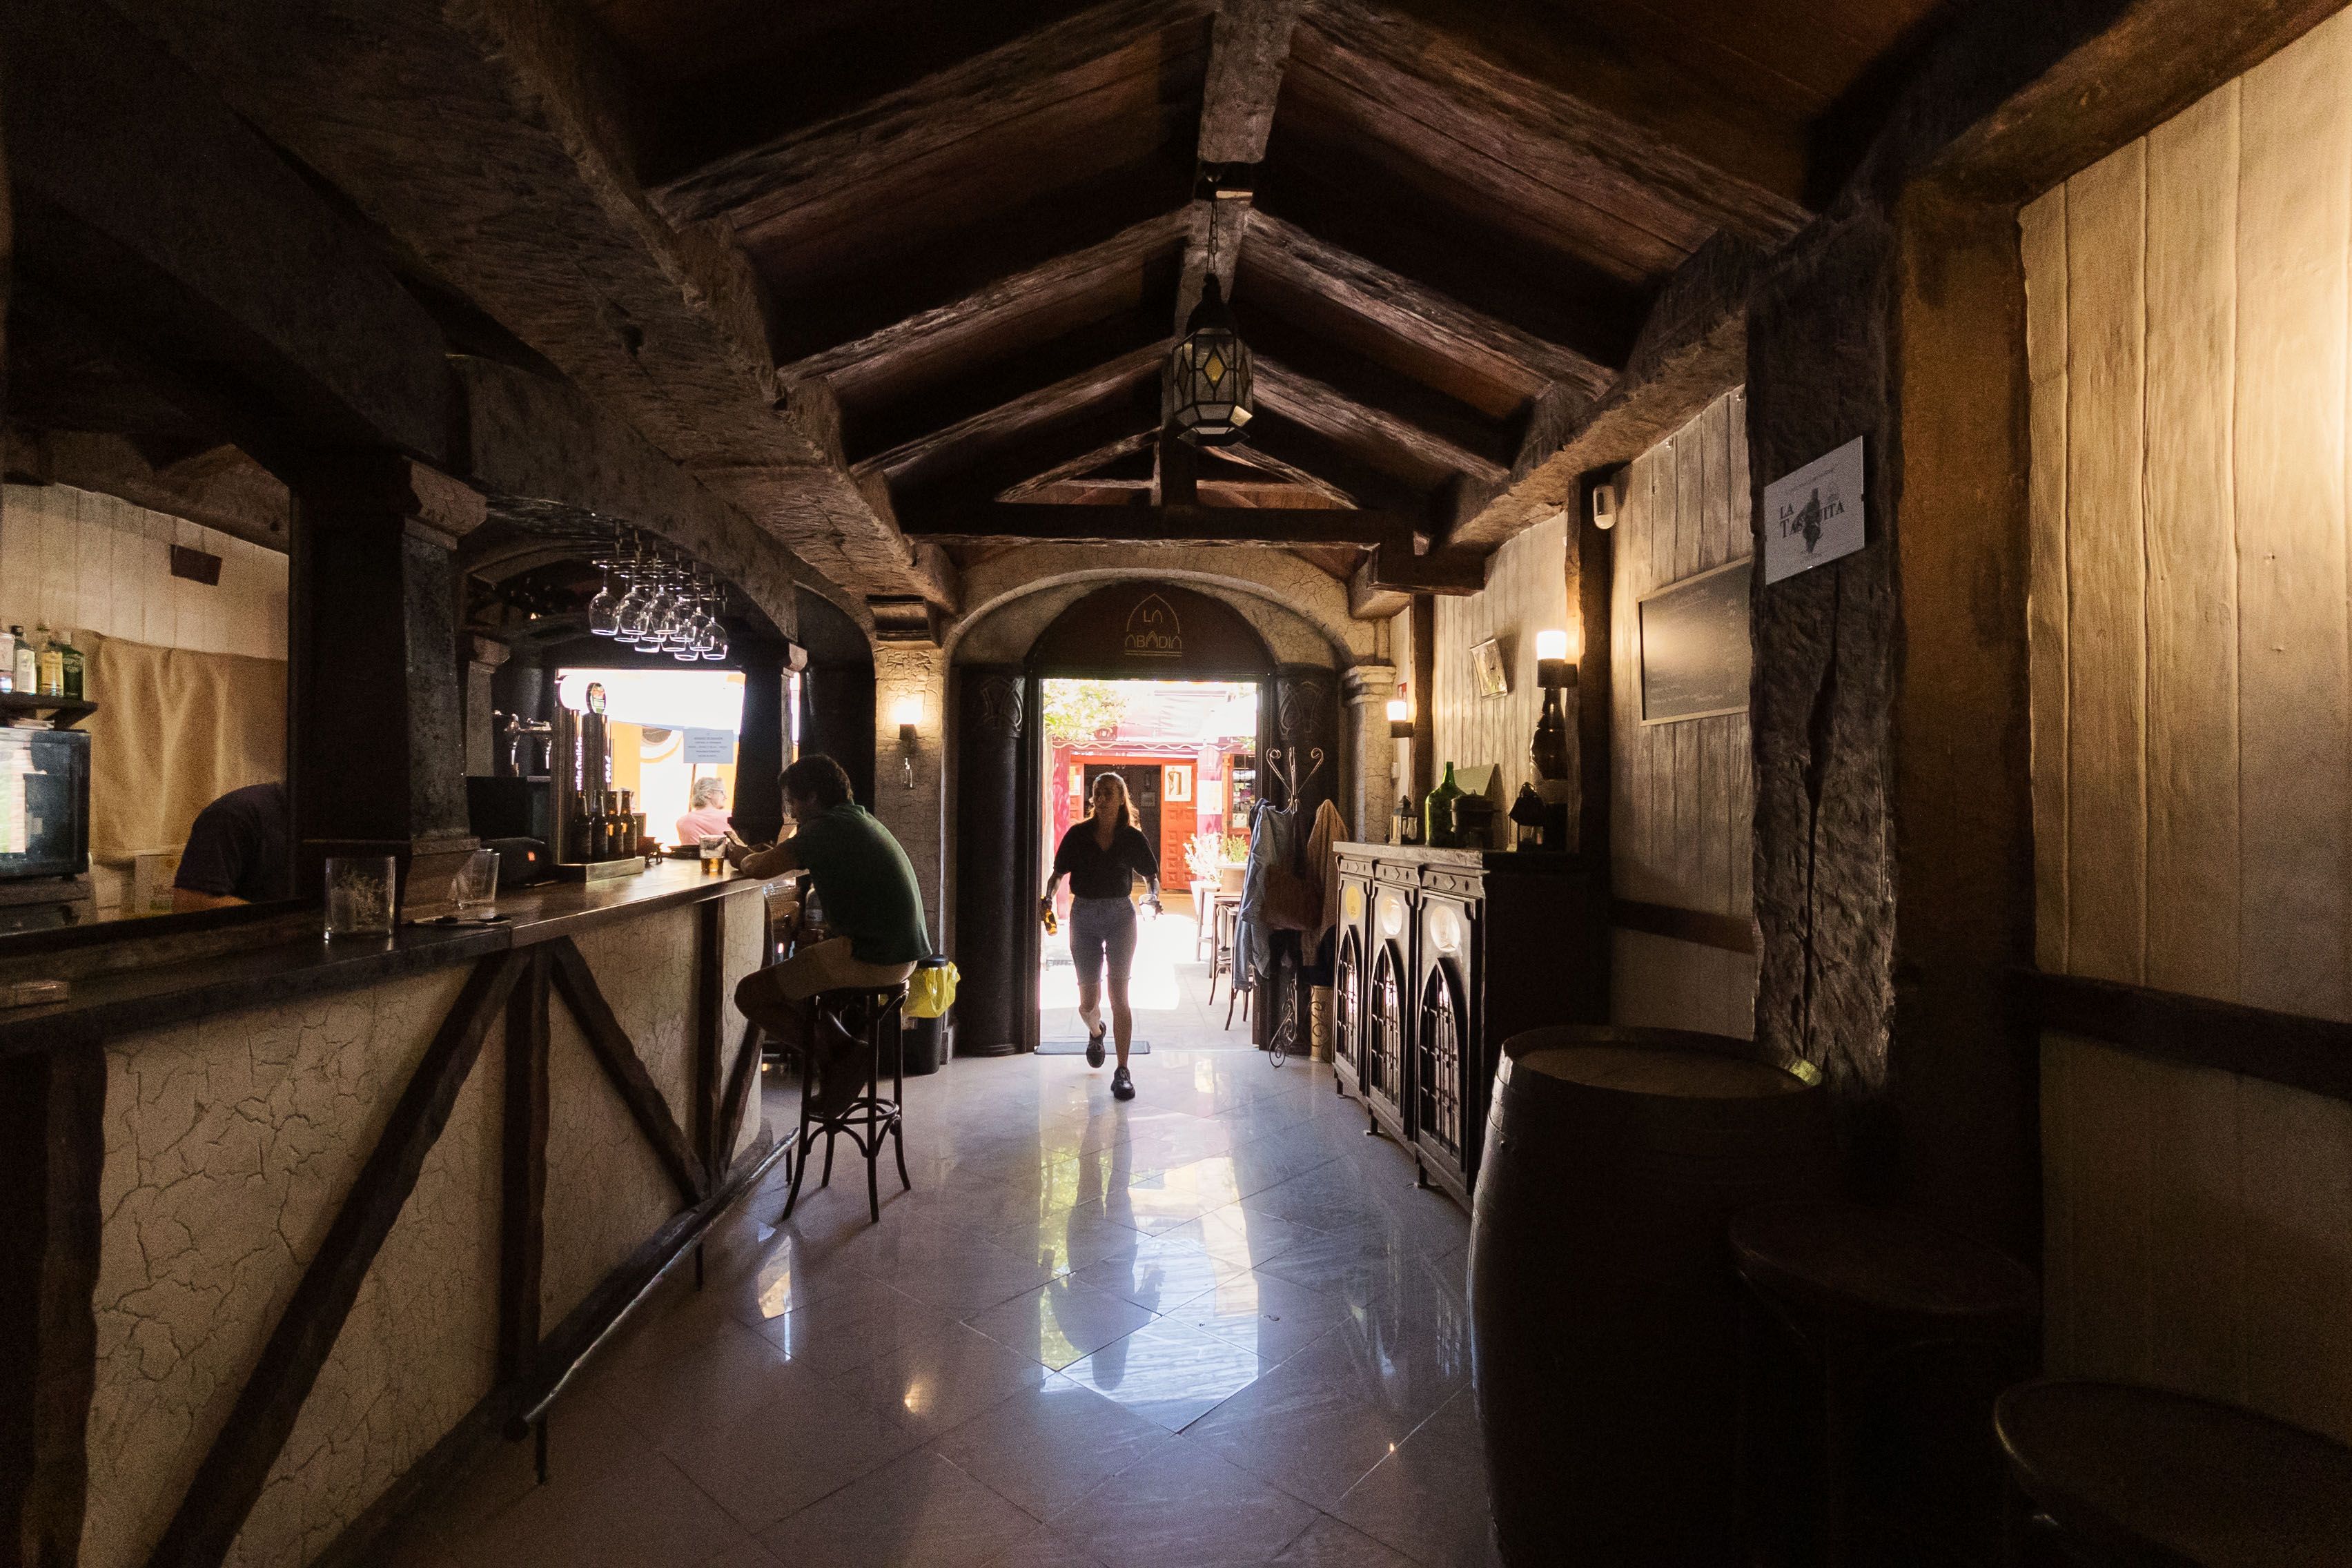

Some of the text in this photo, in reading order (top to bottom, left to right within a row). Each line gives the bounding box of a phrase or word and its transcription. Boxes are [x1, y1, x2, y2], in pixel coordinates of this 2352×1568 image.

[1779, 502, 1794, 519] LA
[1143, 609, 1164, 623] LA
[1124, 630, 1182, 649] ABADIA
